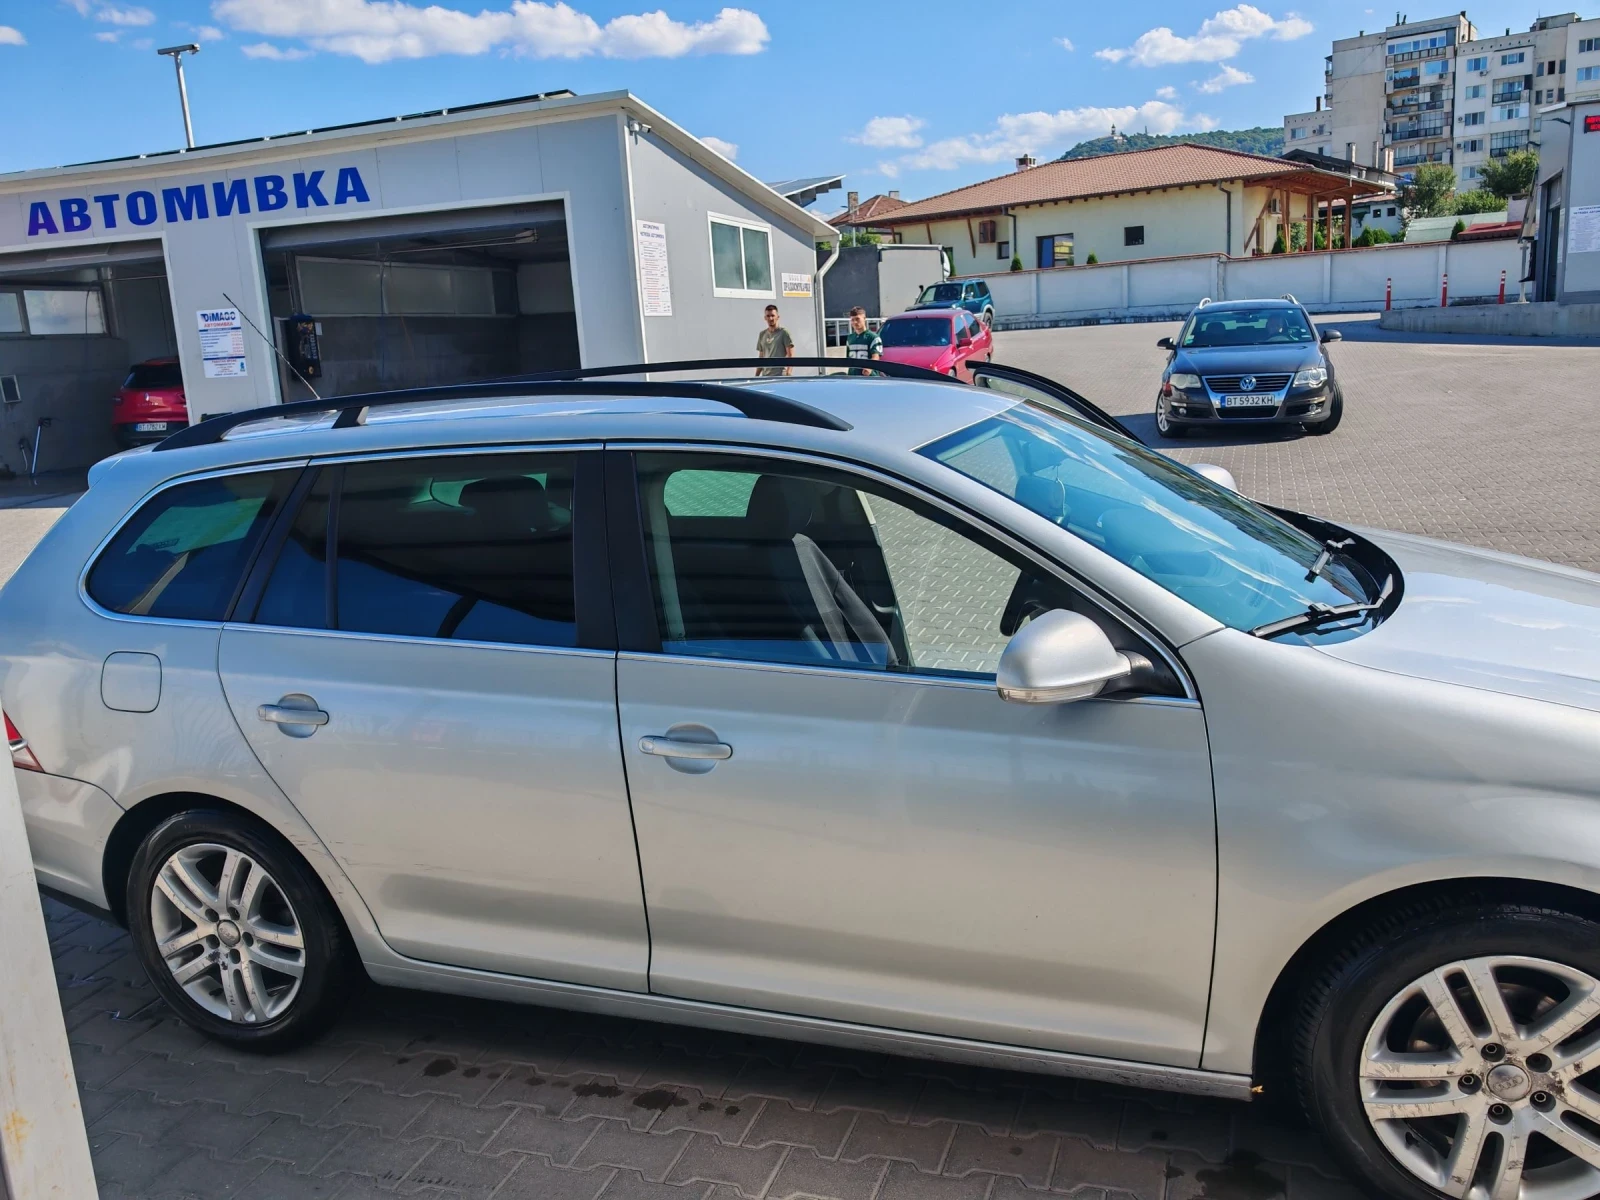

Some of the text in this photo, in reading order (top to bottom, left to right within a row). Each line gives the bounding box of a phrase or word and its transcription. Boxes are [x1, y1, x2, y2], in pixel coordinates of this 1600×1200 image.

[27, 166, 370, 237] АВТОМИВКА
[1226, 395, 1273, 406] BT 5932 KH
